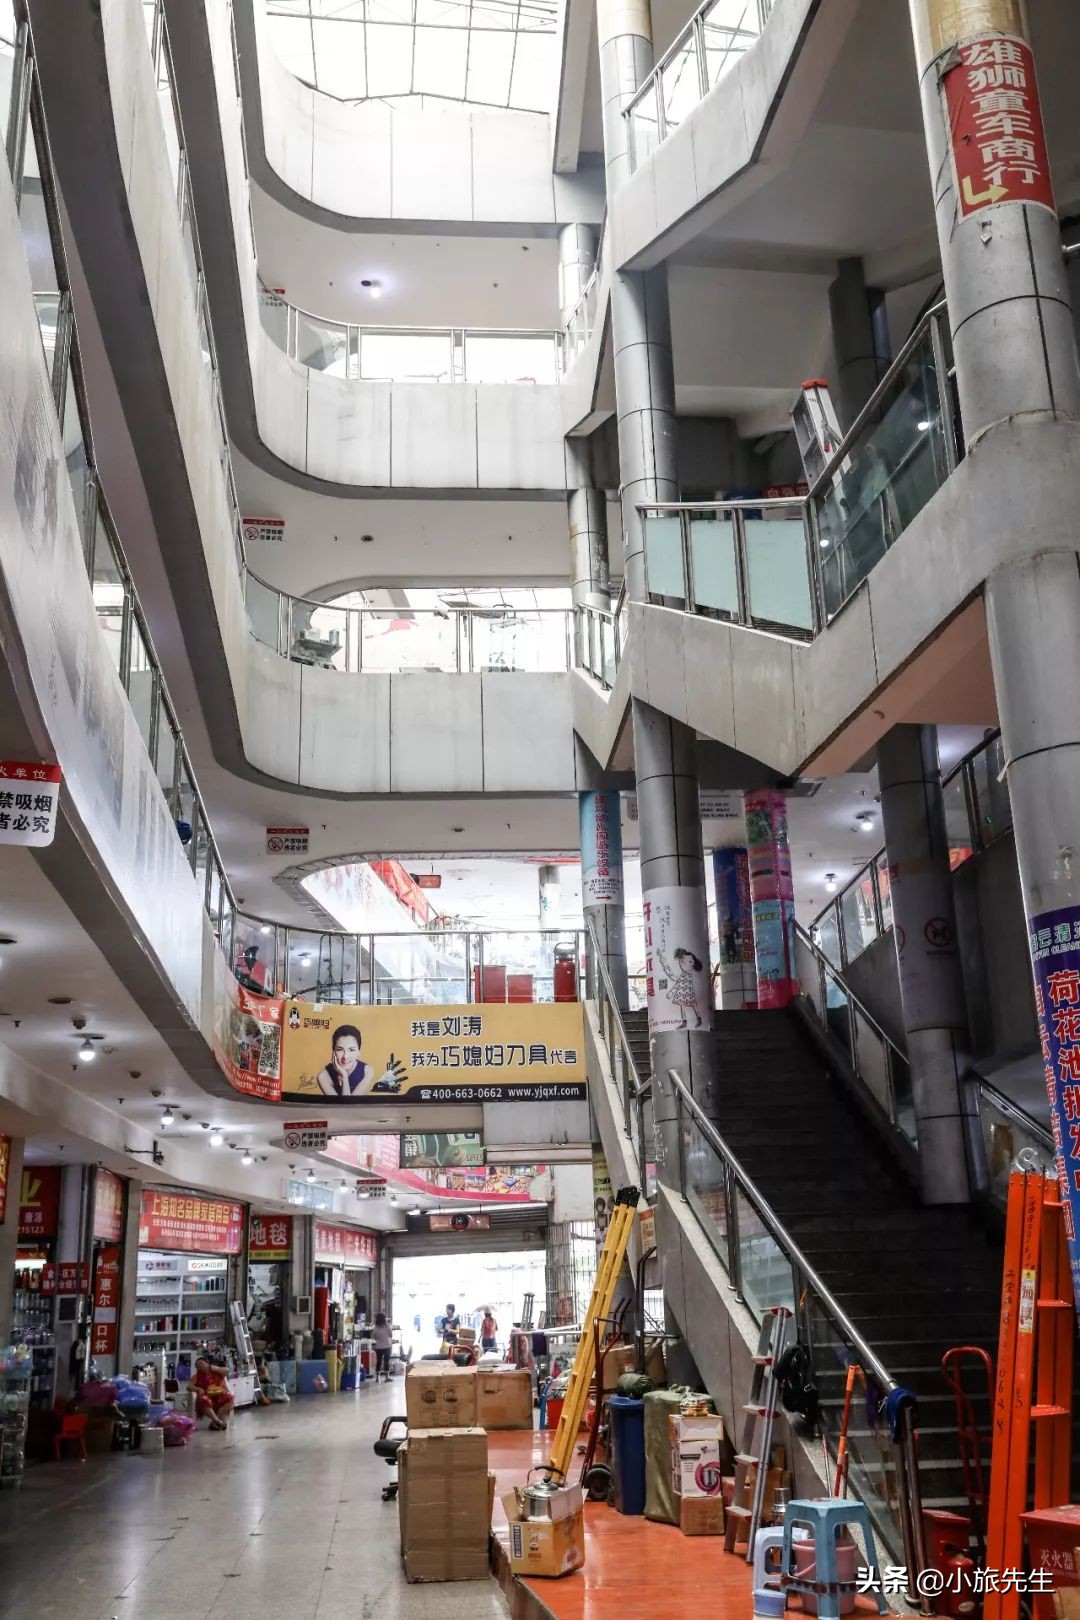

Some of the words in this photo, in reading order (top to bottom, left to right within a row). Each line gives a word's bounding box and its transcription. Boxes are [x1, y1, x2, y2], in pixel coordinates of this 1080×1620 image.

[963, 40, 1041, 187] 雄狮童车商行
[412, 1016, 482, 1037] 我是刘涛
[412, 1044, 577, 1068] 我为巧媳妇刀具代言
[432, 1088, 502, 1099] 400-663-0662
[508, 1086, 579, 1098] www.yjqxf.com
[151, 1194, 230, 1224] 上海知名品牌家居用品
[1040, 1549, 1074, 1570] 灭火器
